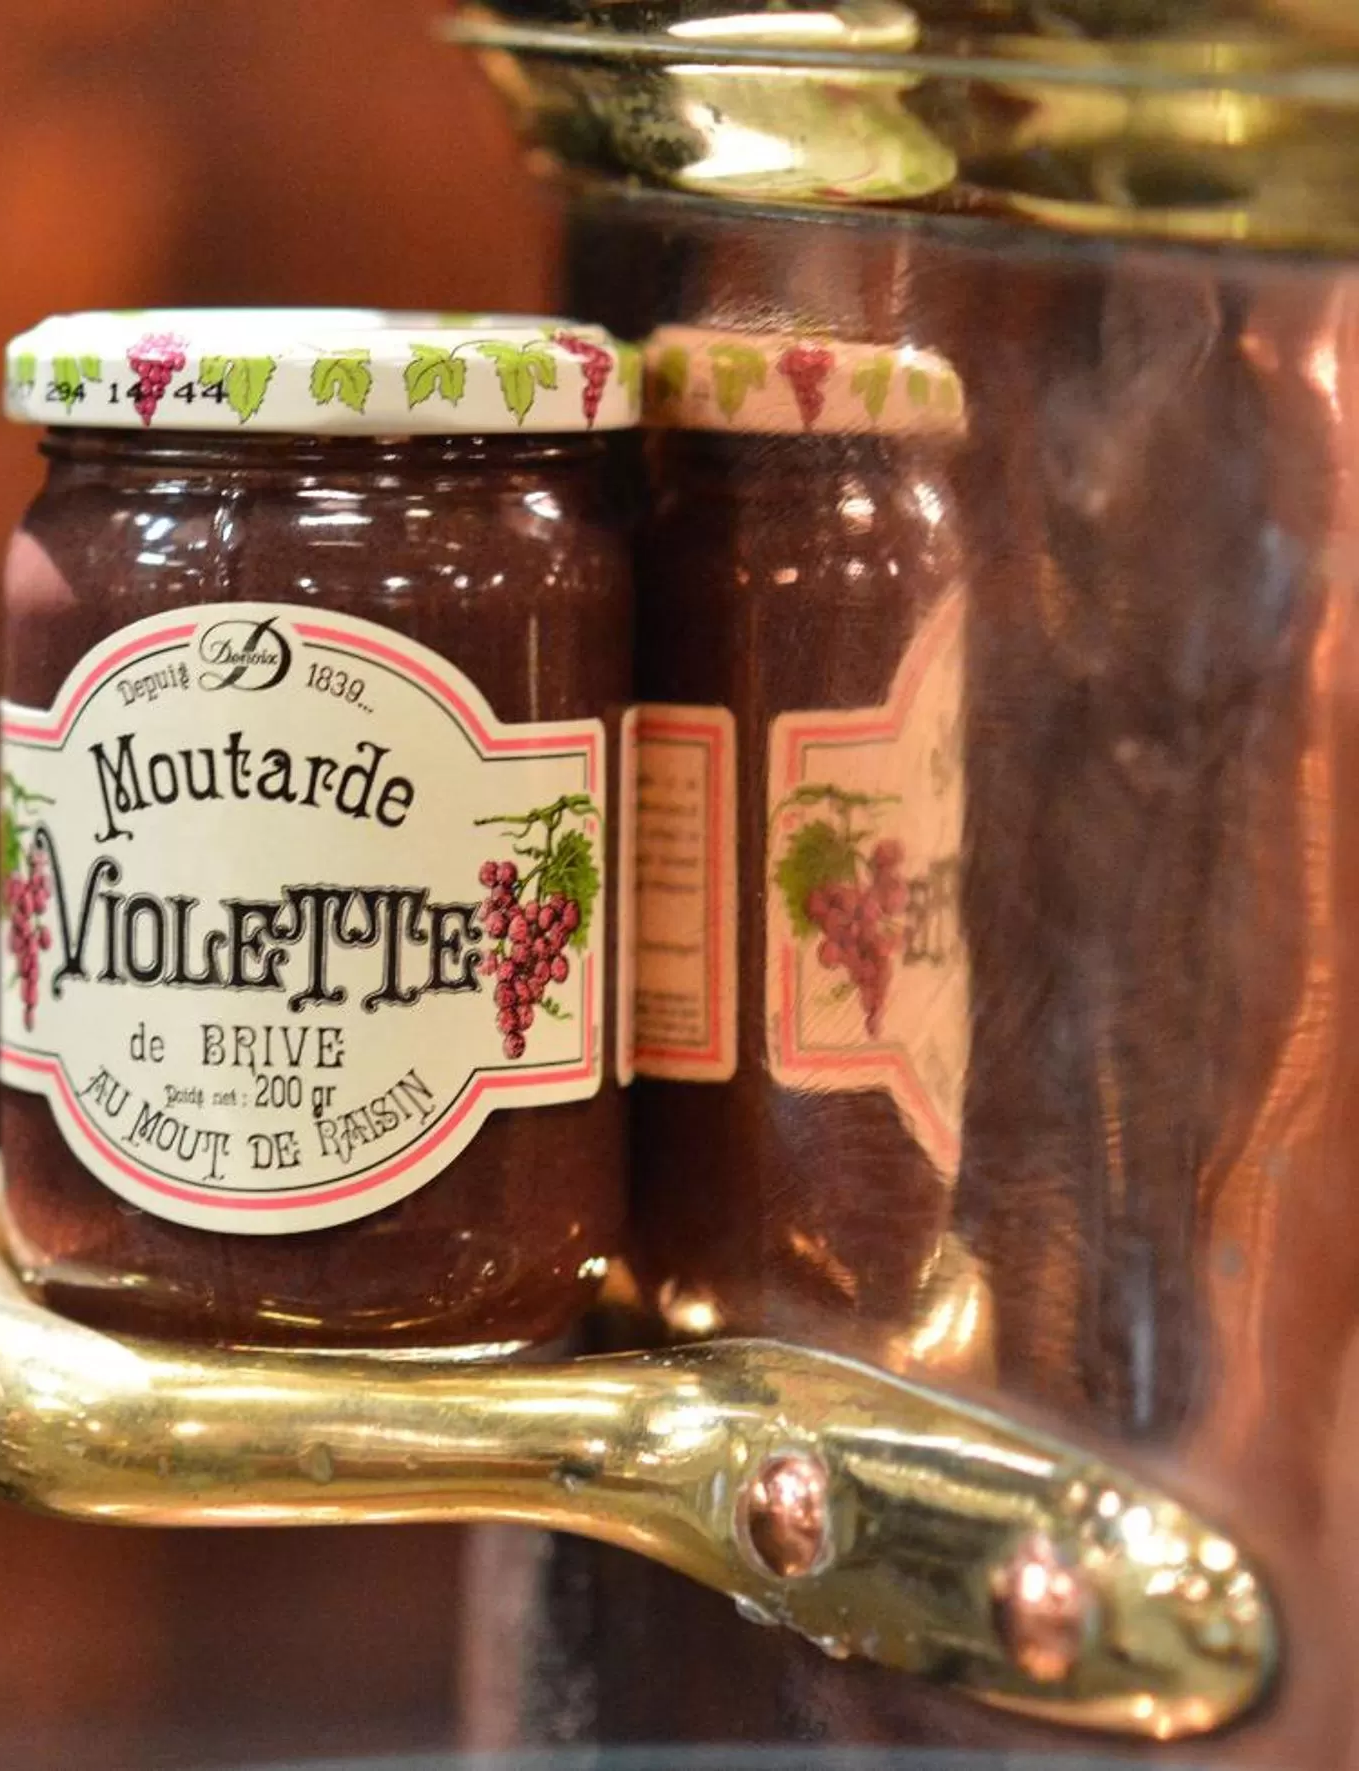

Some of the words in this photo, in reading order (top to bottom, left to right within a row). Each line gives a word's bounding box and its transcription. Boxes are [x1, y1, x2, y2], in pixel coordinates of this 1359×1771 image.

[173, 379, 229, 404] 44
[116, 661, 190, 706] Depuis
[89, 731, 415, 843] Moutarde
[34, 826, 484, 1013] VIOLETTE
[129, 1022, 165, 1063] de
[200, 1023, 345, 1077] BRIVE
[79, 1064, 132, 1118] AU
[121, 1103, 231, 1181] MOUT
[248, 1130, 302, 1170] DE
[314, 1068, 437, 1165] RAISIN
[255, 1074, 302, 1109] 200
[311, 1086, 337, 1119] gr
